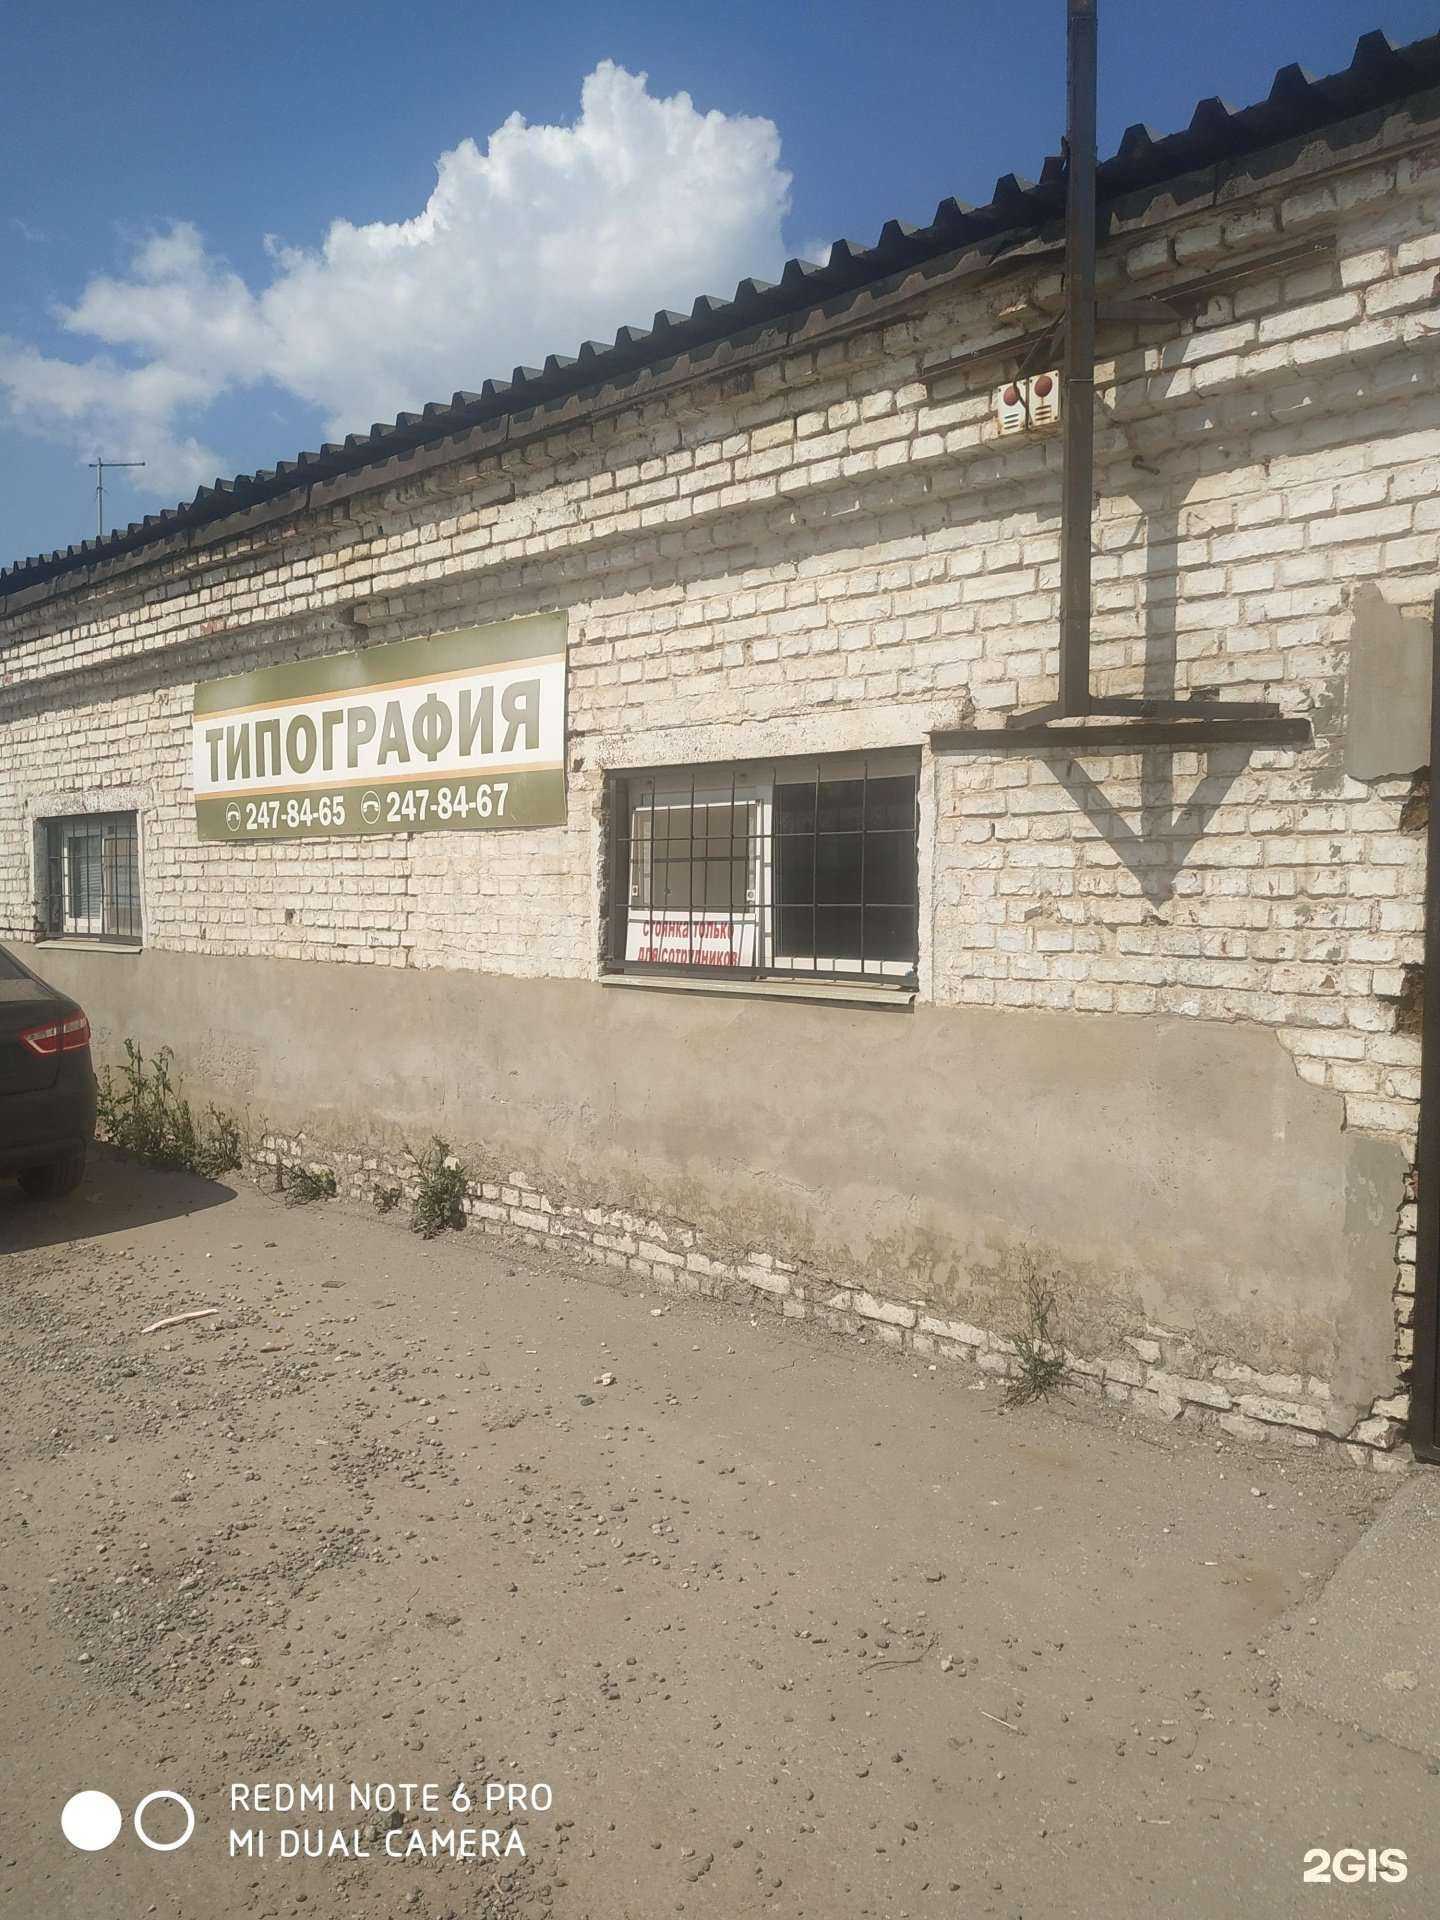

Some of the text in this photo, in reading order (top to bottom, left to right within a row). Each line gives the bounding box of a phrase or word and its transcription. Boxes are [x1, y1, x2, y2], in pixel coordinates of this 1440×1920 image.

[205, 677, 542, 784] ТИПОГРАФИЯ
[246, 783, 510, 830] 247-84-65 247-84-67
